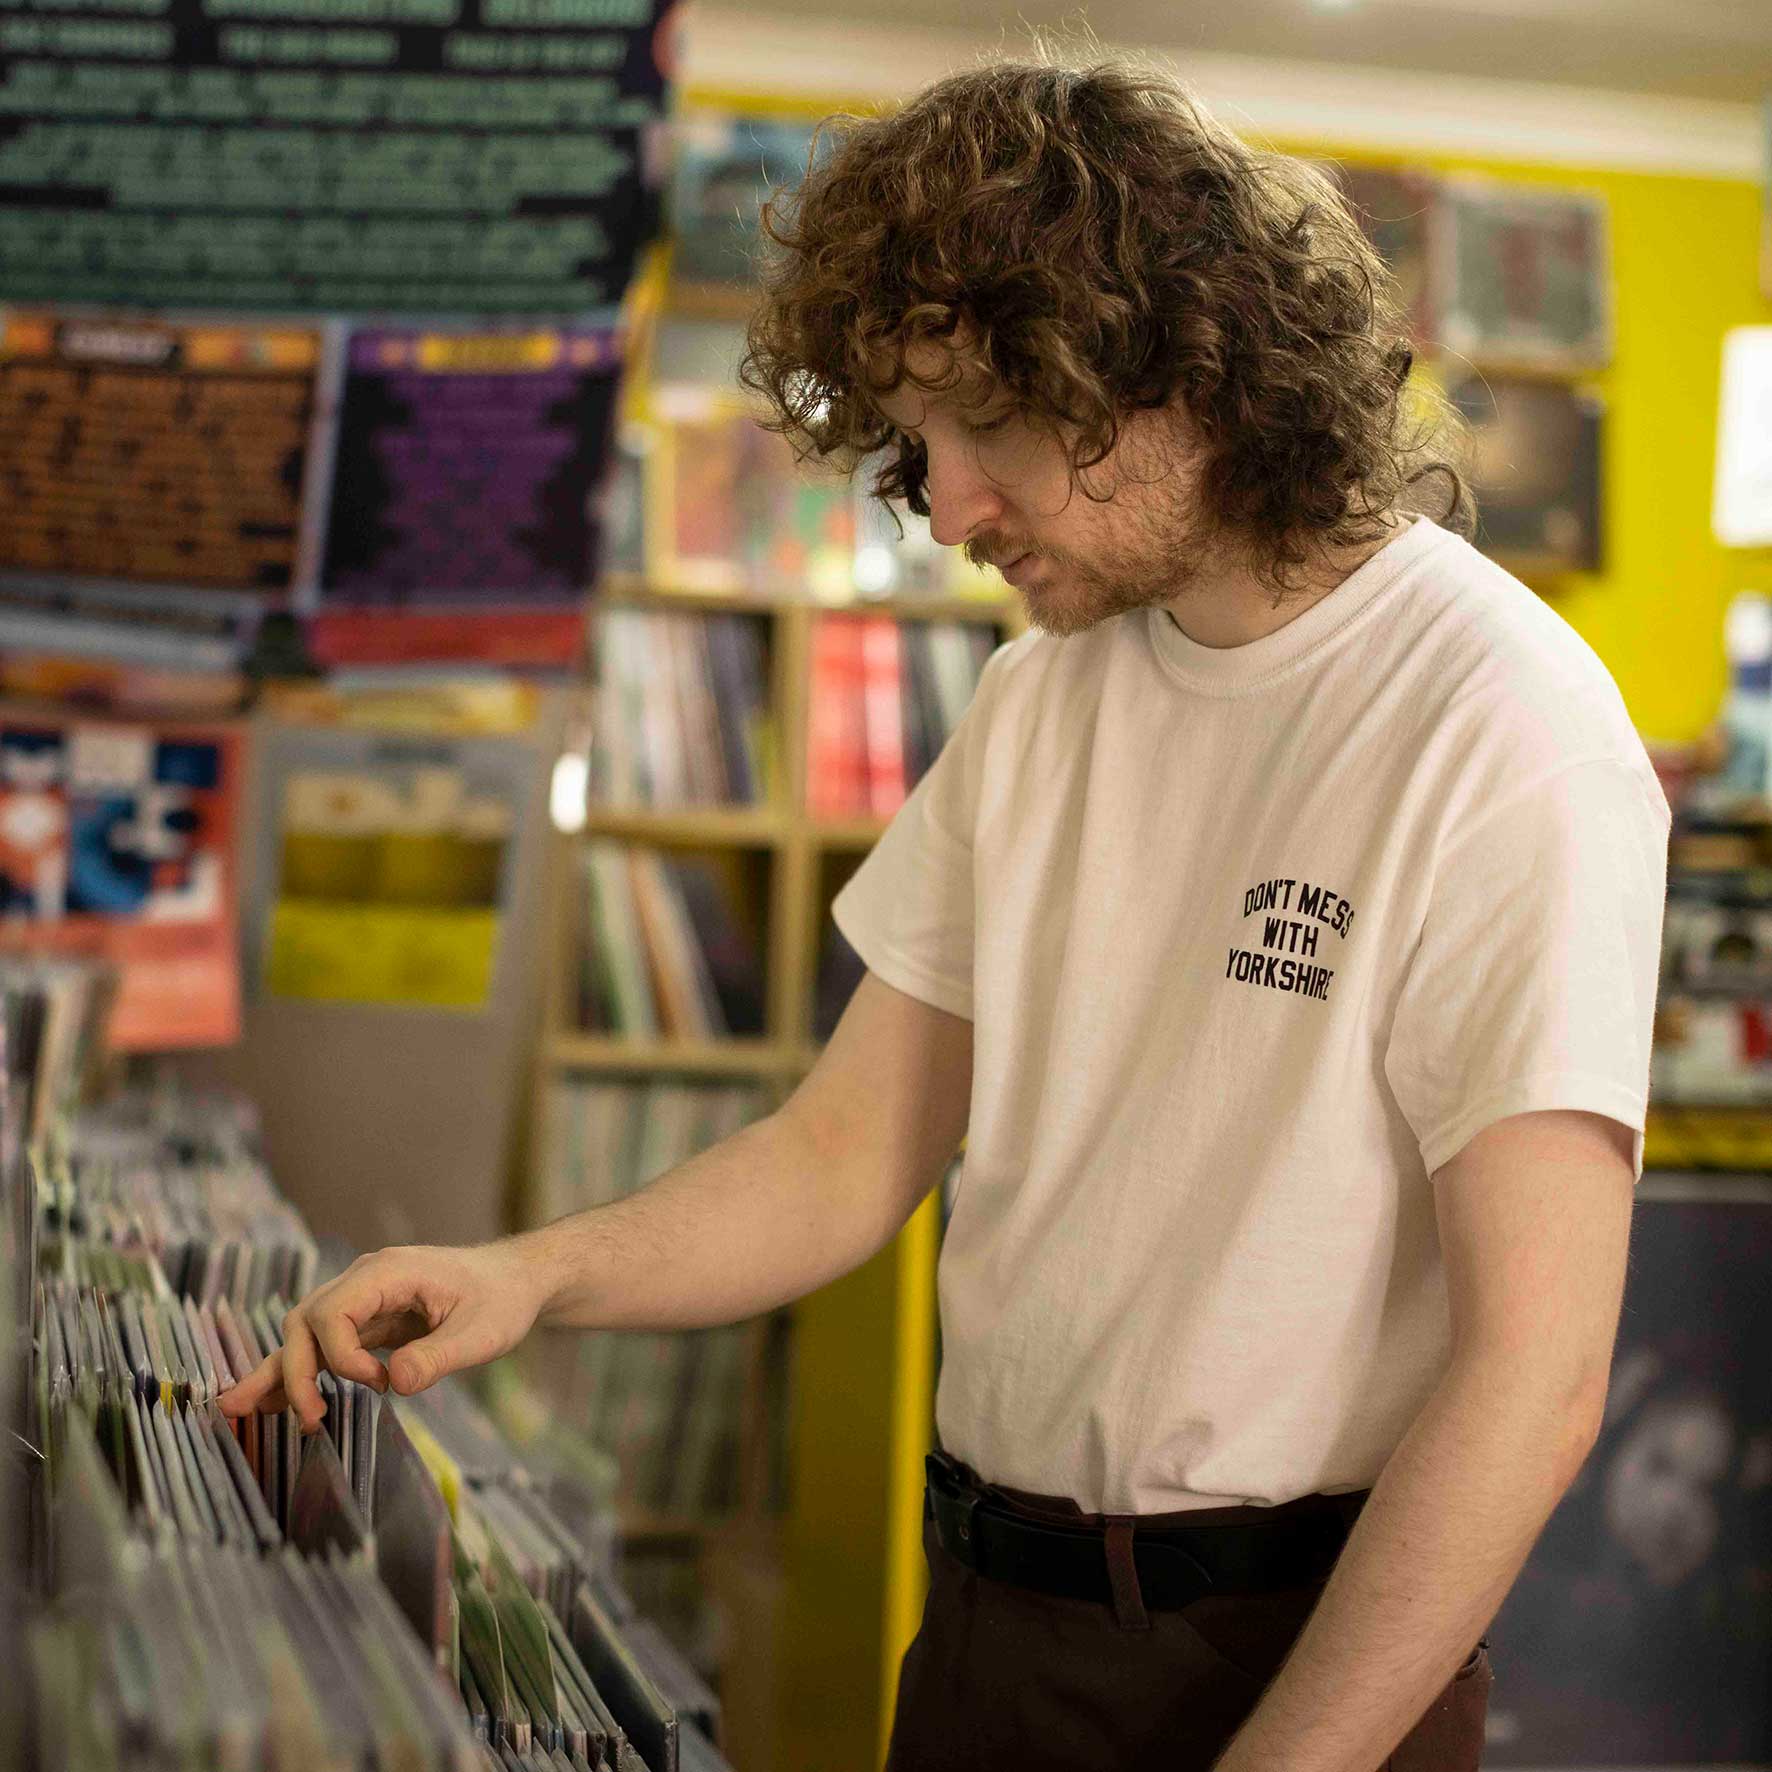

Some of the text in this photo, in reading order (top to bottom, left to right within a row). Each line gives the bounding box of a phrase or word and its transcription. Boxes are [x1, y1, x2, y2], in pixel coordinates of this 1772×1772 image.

[1244, 879, 1354, 939] DON'T MESS
[1263, 917, 1319, 957] WITH
[1226, 948, 1334, 1001] YORKSHIRE
